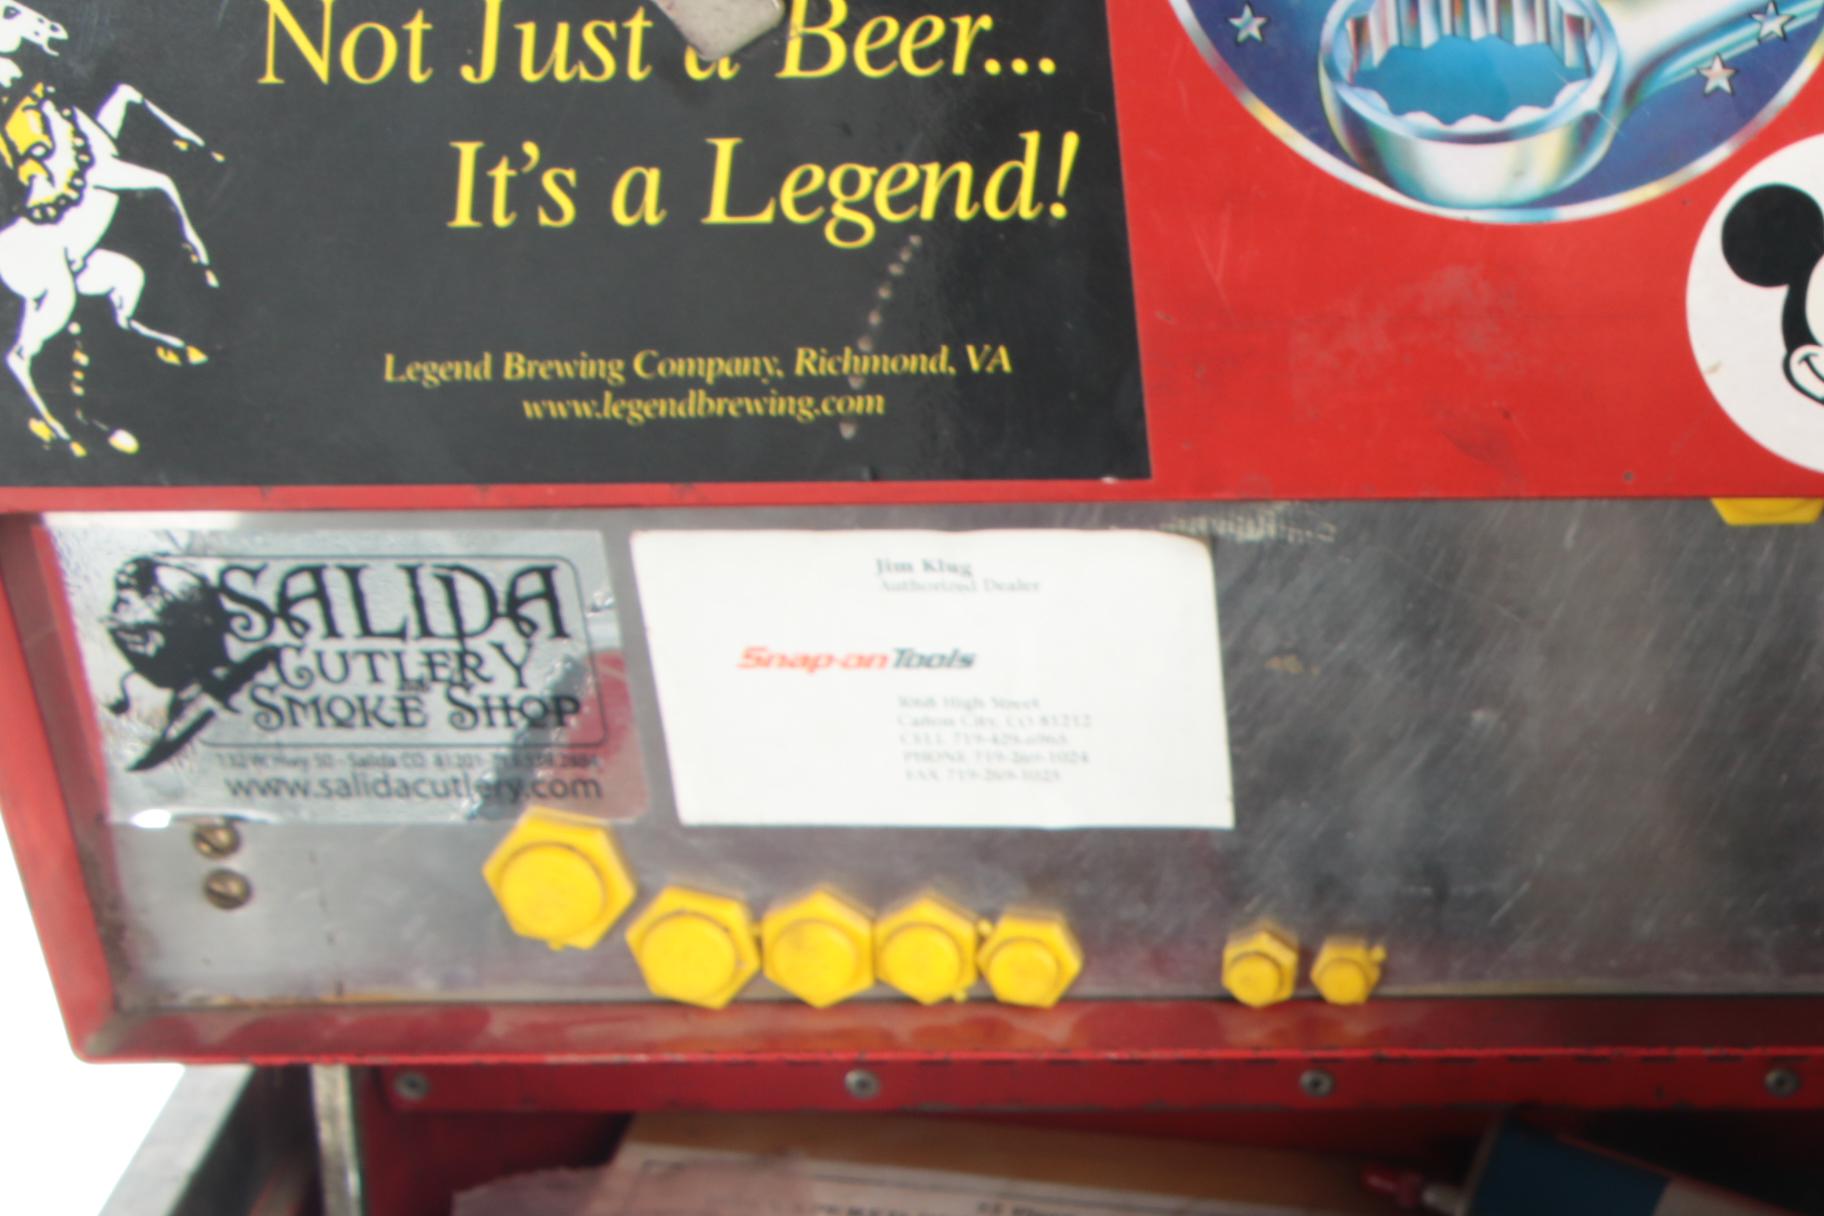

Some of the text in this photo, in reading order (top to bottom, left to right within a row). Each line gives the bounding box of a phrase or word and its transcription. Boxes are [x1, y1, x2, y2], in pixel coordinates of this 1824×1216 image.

[258, 0, 431, 84] Not
[460, 0, 652, 82] Just
[447, 131, 1080, 249] It's a Legend!
[384, 344, 1013, 389] Legend Brewing Company, Richmond, VA
[522, 389, 886, 426] www.legendbrewing.com
[874, 558, 915, 577] Jim
[983, 578, 1041, 593] Dealer
[218, 562, 571, 643] SALIDA
[274, 640, 535, 690] CUTLERY
[736, 646, 977, 674] Snap-on Tools
[250, 683, 581, 732] SMOKE SHOP
